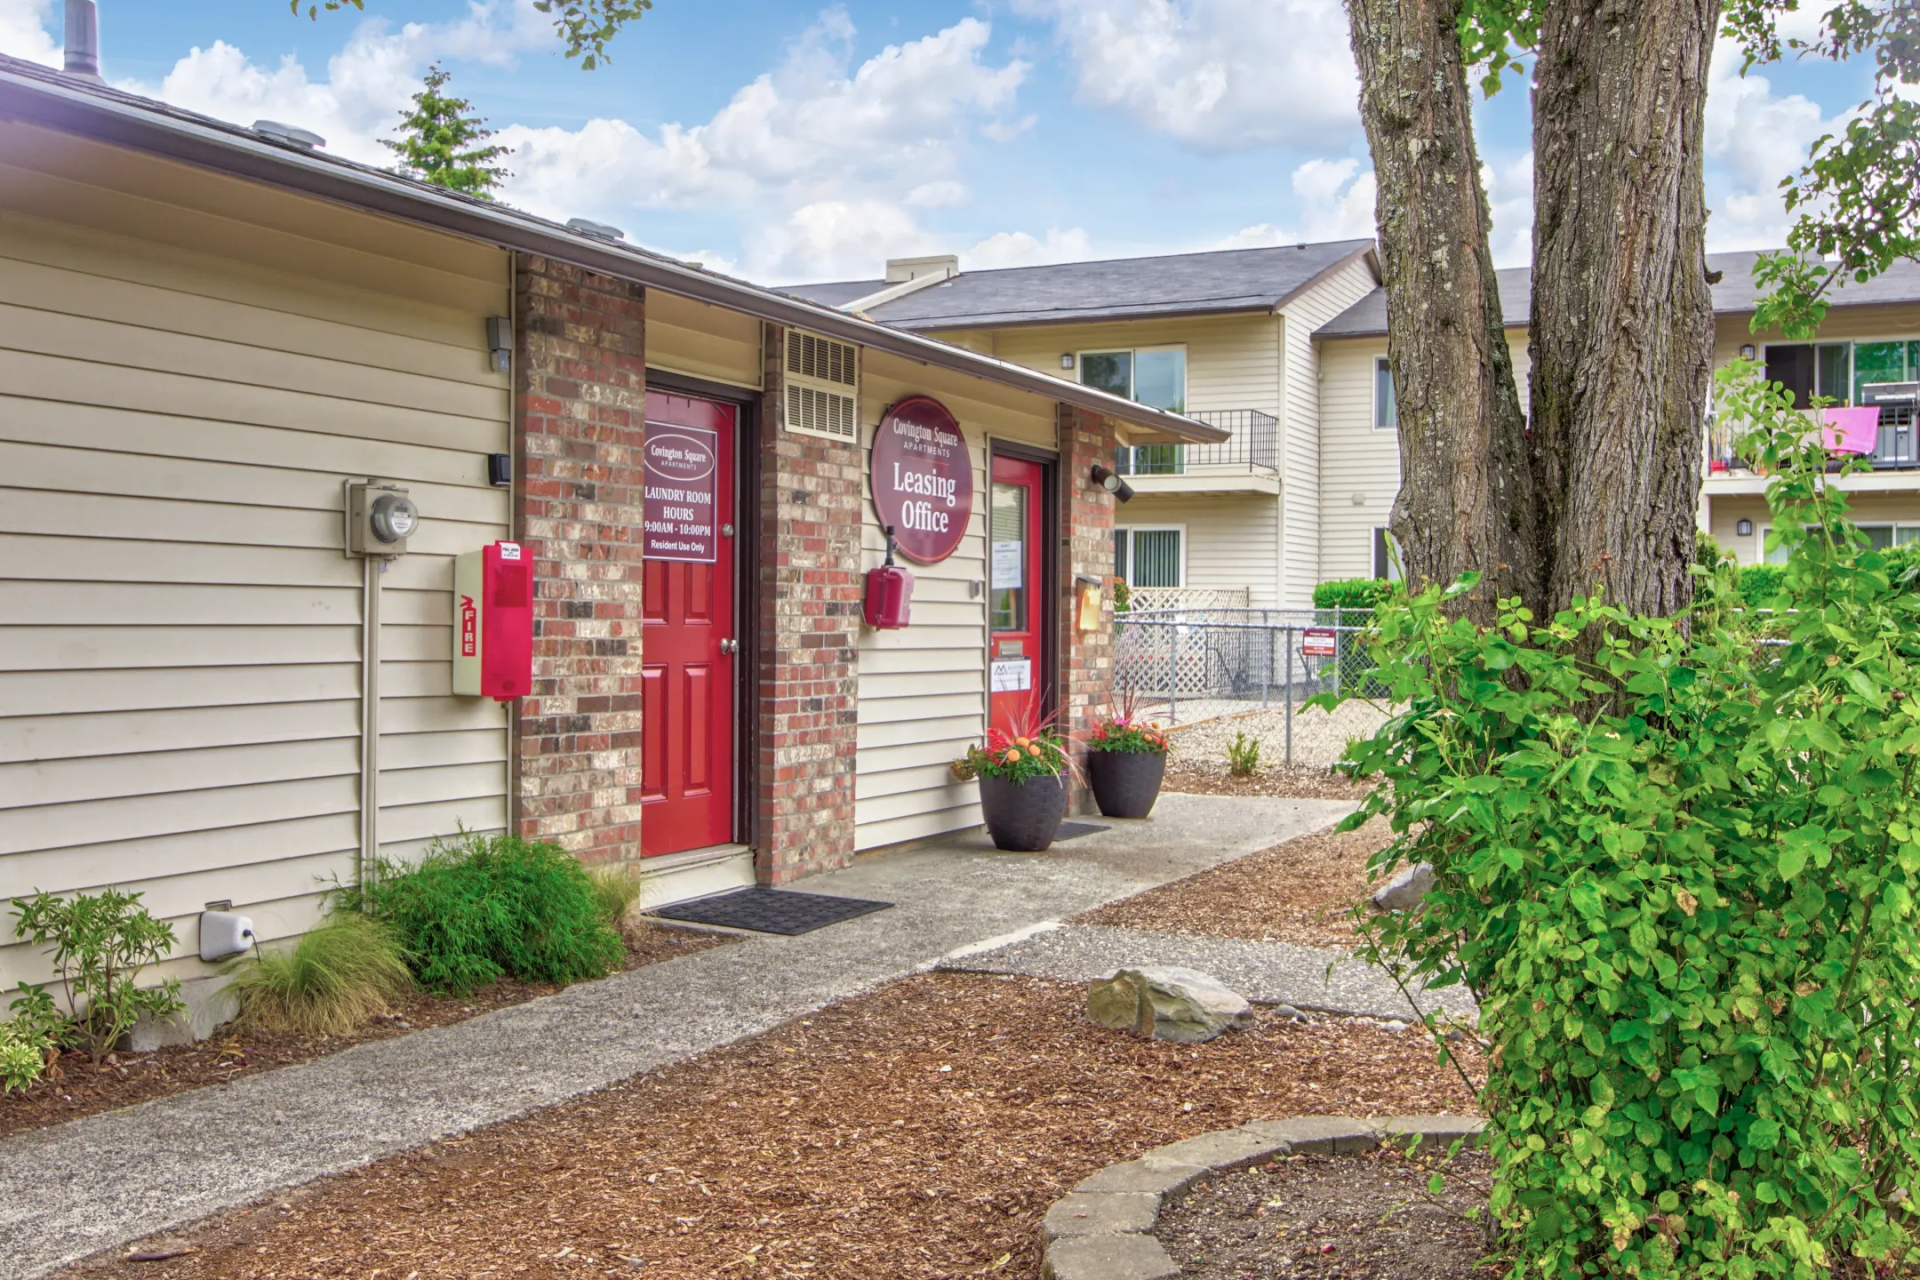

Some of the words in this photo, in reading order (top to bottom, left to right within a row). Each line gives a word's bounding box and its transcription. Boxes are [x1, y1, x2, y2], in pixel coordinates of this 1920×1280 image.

[893, 418, 932, 442] Covington
[934, 427, 958, 448] Square
[651, 444, 683, 461] Covington
[684, 448, 706, 464] Square
[903, 441, 950, 458] APARTMENTS
[661, 460, 697, 470] APARTMENTS
[893, 462, 956, 507] Leasing
[644, 486, 685, 502] LAUNDRY
[686, 490, 711, 504] ROOM
[663, 506, 694, 521] HOURS
[901, 500, 949, 533] Office
[644, 520, 674, 534] 9:00AM
[679, 523, 711, 537] 10:00PM
[650, 539, 678, 550] Resident
[678, 541, 690, 551] Use
[690, 542, 705, 554] Only
[464, 610, 474, 653] FIRE
